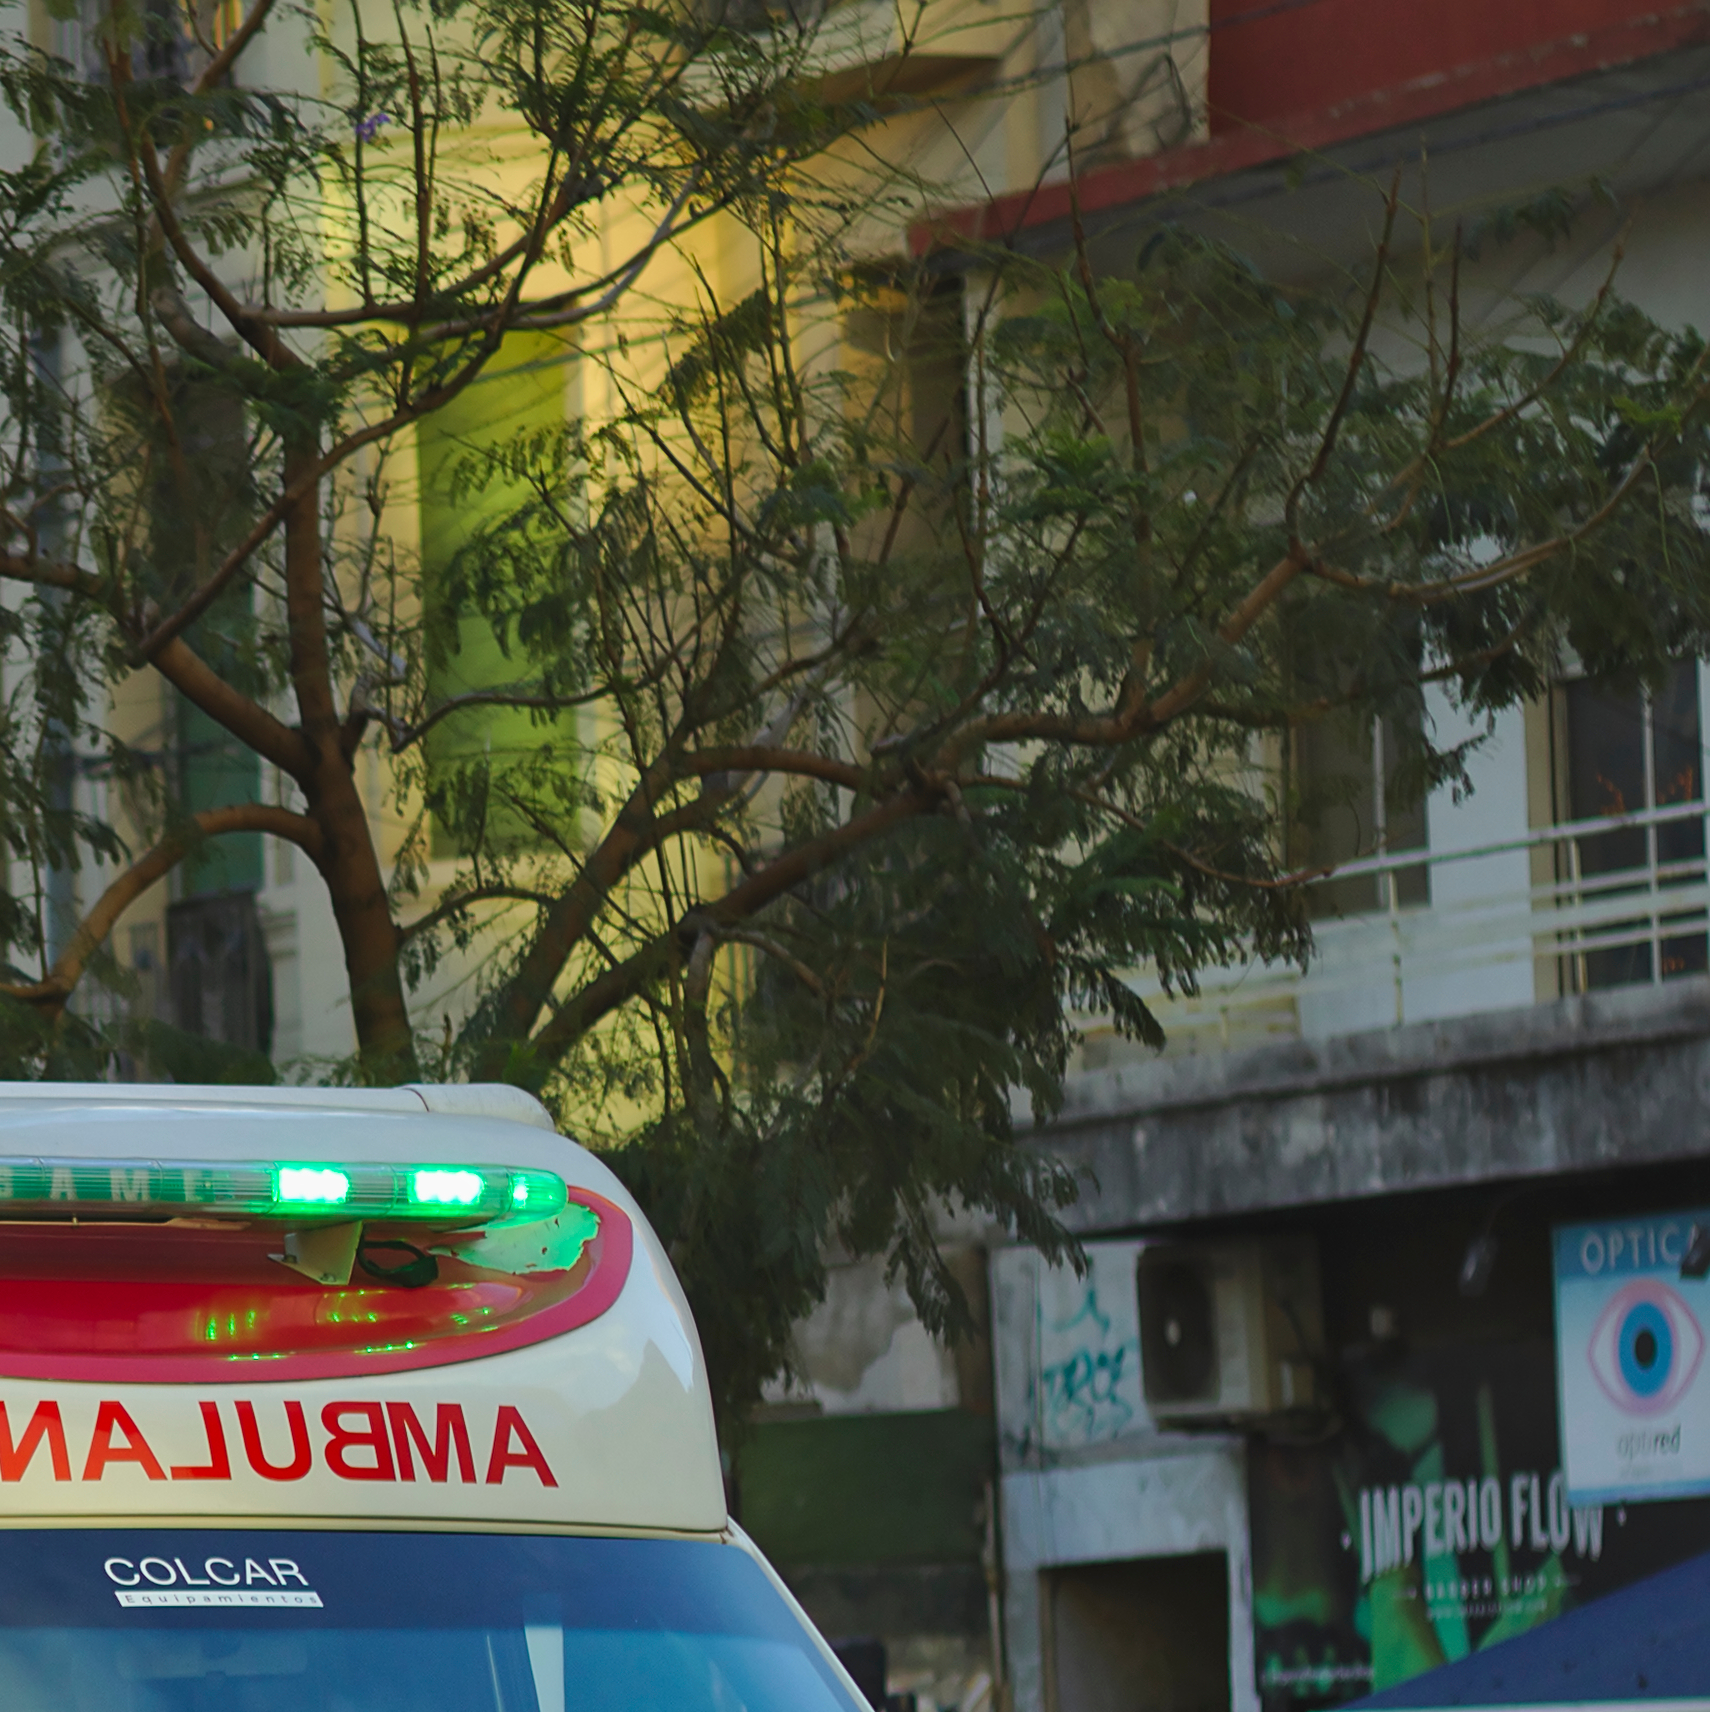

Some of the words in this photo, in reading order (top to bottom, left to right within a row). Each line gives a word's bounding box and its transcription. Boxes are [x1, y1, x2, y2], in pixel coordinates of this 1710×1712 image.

[1358, 1477, 1503, 1585] IMPERIO
[104, 1556, 309, 1586] COLCAR
[124, 1594, 319, 1605] Equipamientos
